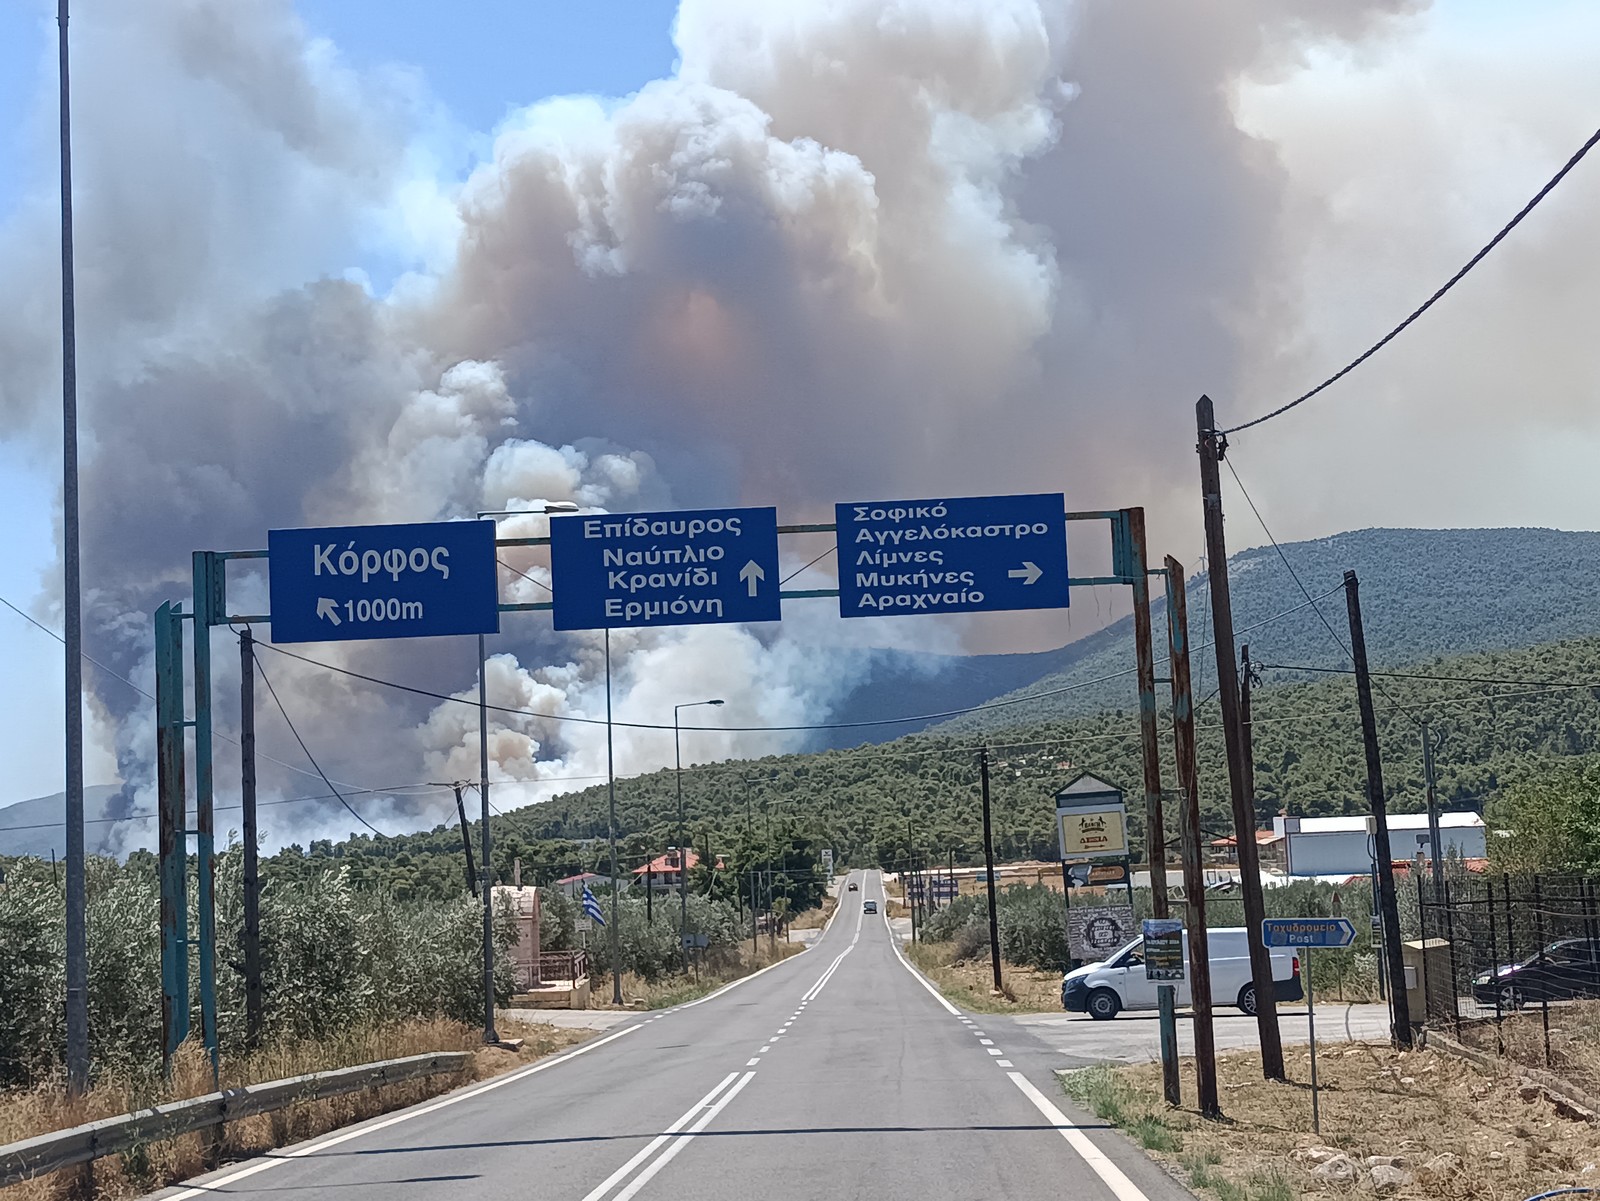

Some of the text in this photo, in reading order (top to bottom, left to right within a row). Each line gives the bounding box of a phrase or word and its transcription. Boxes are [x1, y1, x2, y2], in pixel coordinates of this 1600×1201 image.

[853, 502, 947, 523] Σοφικό
[583, 517, 741, 540] Επίδαυρος
[854, 522, 1049, 545] Αγγελόκαστρο
[313, 542, 450, 584] Κόρφος
[602, 544, 724, 567] Ναύπλιο
[855, 549, 944, 568] Λίμνες
[607, 567, 717, 593] Κρανίδι
[855, 569, 975, 588] Μυκήνες
[344, 598, 424, 623] 1000m
[604, 595, 723, 621] Ερμιόνη
[857, 588, 985, 610] Αραχναίο
[1265, 922, 1337, 933] Ταχυδρομείο
[1289, 934, 1314, 944] Post
